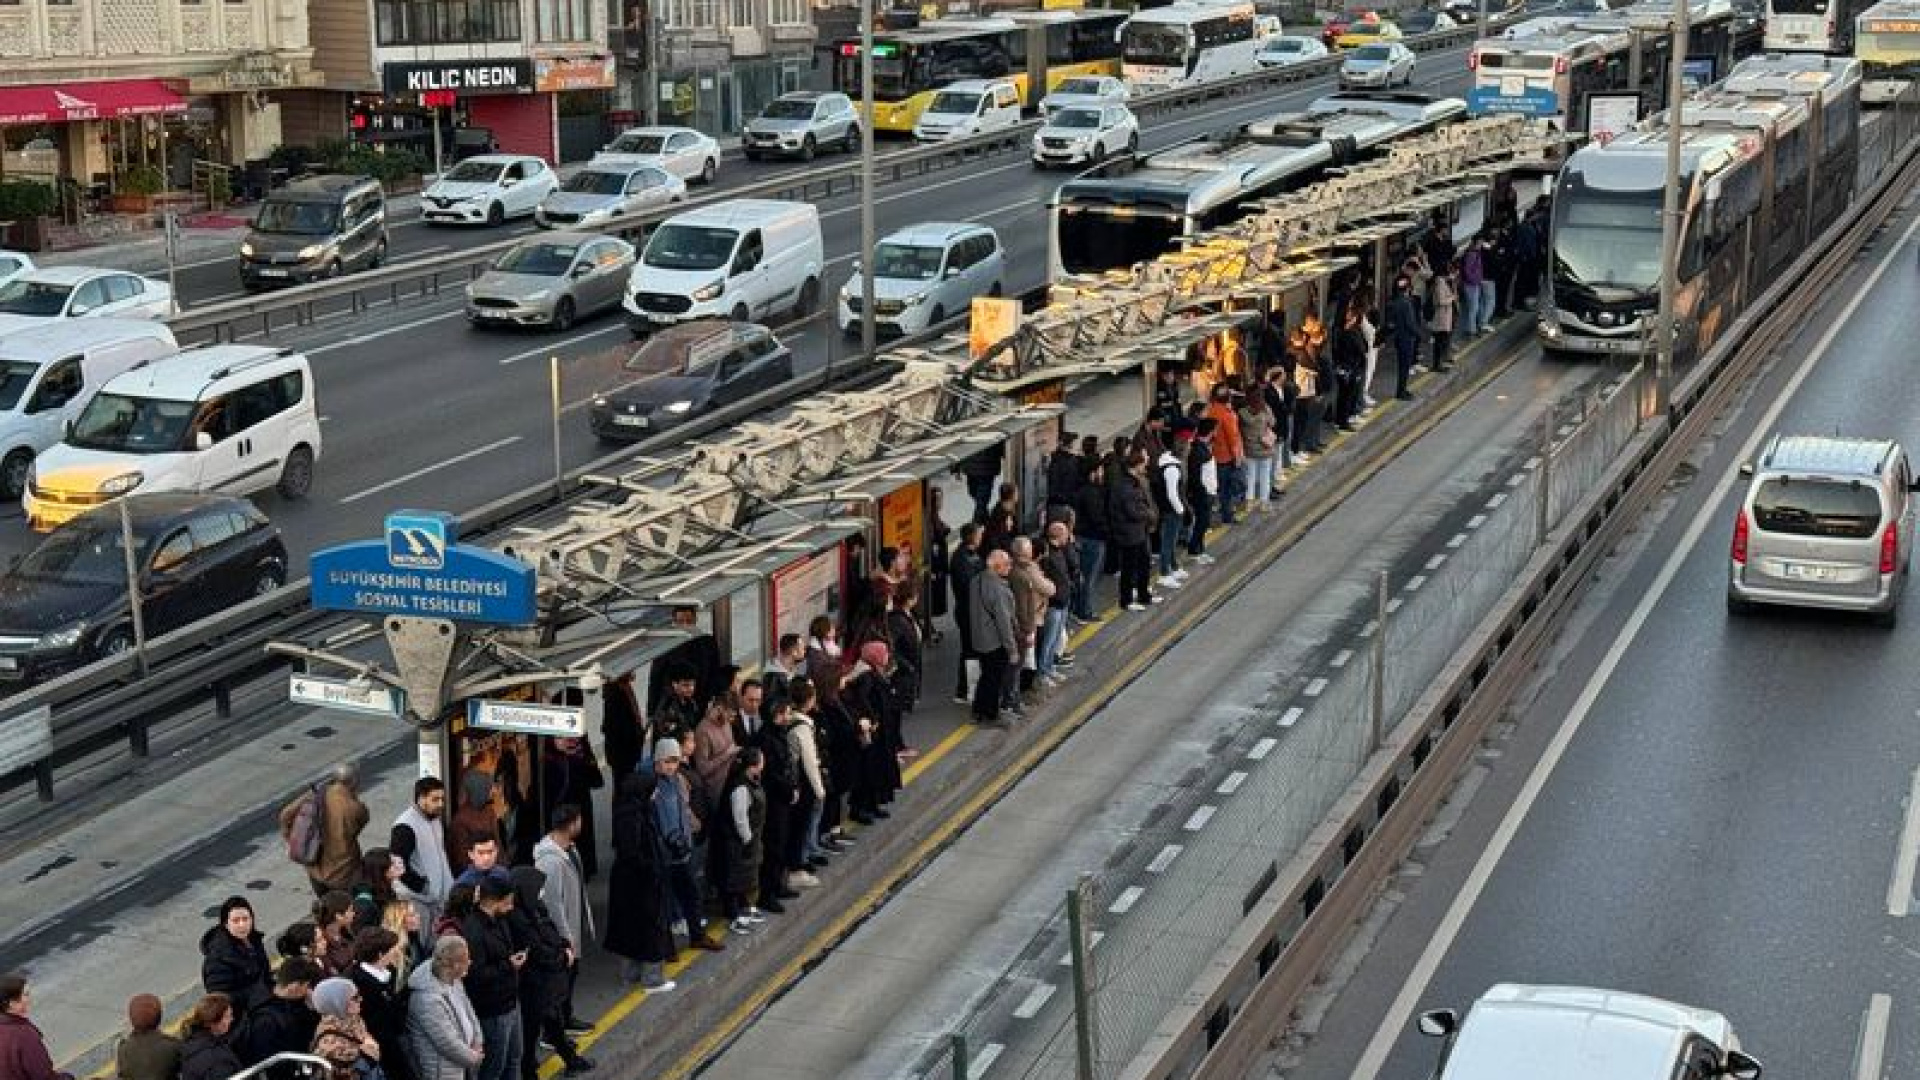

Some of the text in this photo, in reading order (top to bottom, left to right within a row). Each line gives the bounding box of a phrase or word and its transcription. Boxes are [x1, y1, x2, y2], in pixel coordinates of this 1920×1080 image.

[465, 66, 517, 86] NEON
[425, 576, 507, 596] BELEDİYESİ
[354, 591, 481, 615] SOSYAL TESİSLERİ
